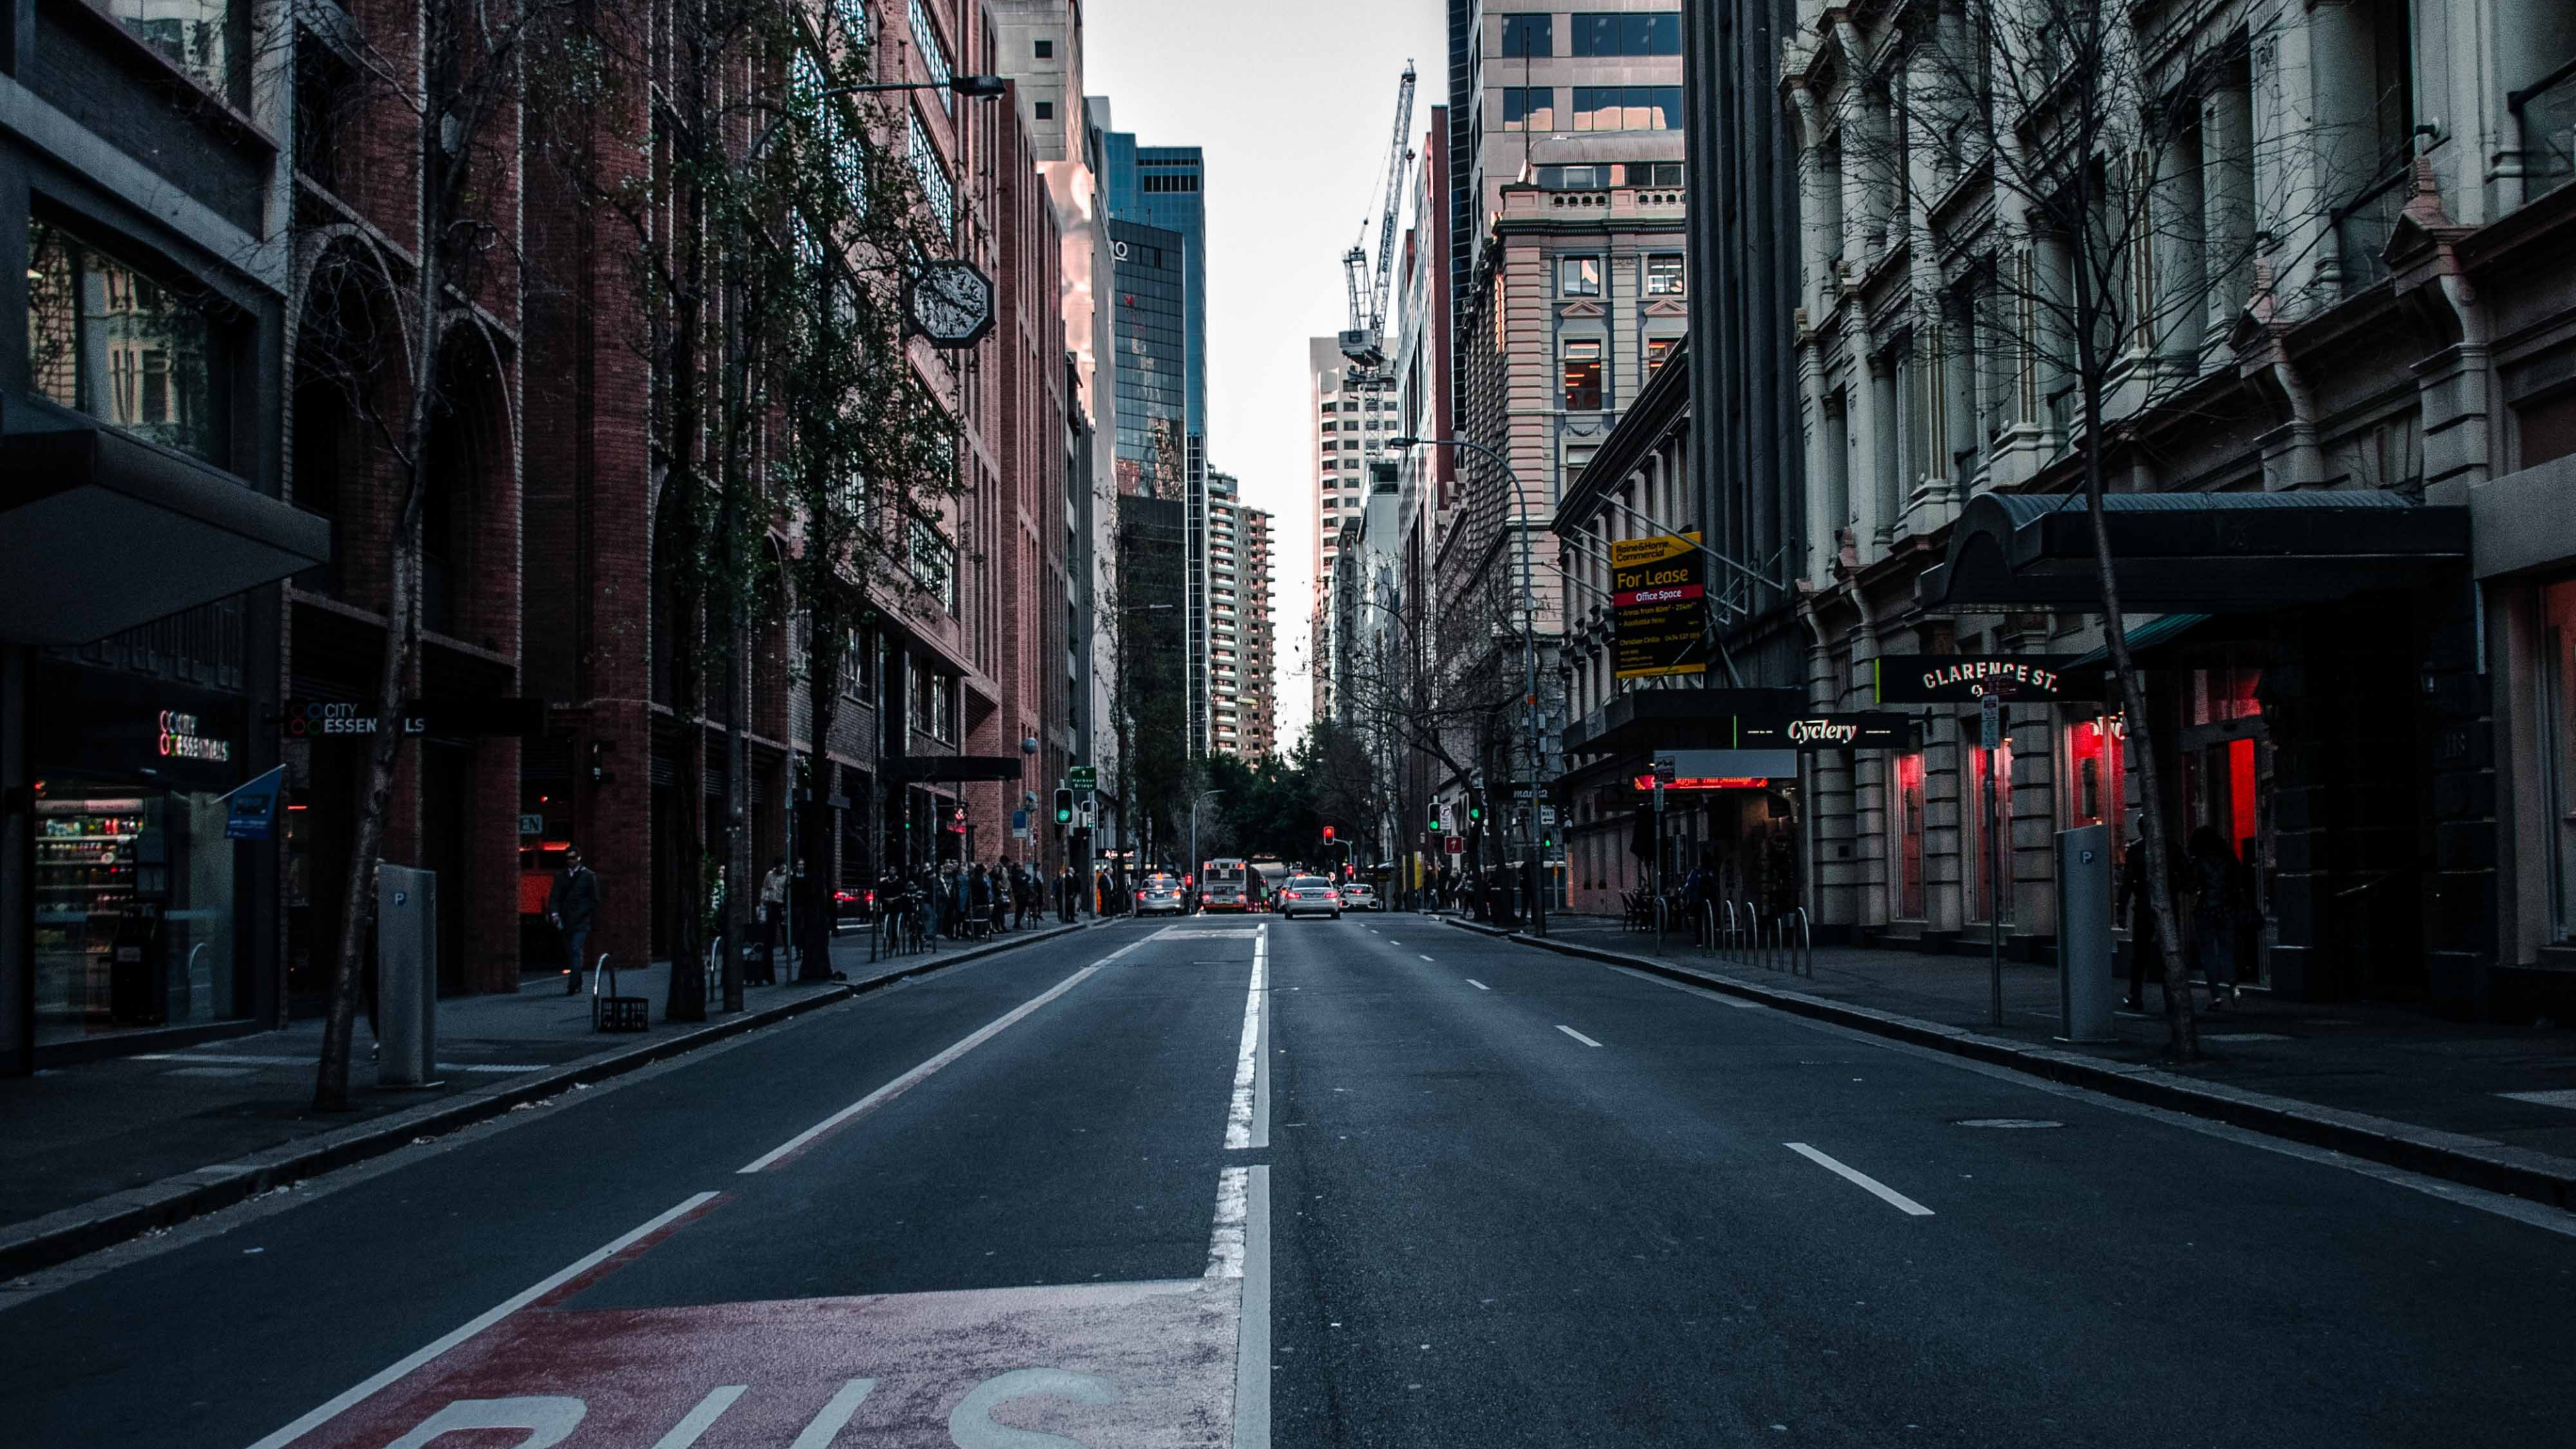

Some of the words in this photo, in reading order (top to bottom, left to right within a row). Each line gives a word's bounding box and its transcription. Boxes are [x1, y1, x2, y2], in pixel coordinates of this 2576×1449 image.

[1616, 549, 1664, 562] Commercial
[1617, 573, 1642, 589] For
[1646, 568, 1689, 586] Lease
[1635, 591, 1658, 602] Office
[1659, 590, 1682, 601] Space
[1923, 661, 2029, 690] CLARENCE
[2032, 668, 2058, 692] ST.
[325, 703, 358, 718] CITY
[325, 718, 425, 733] ESSENLS
[1787, 718, 1858, 745] Cyclery
[2083, 851, 2092, 863] P
[394, 893, 405, 905] P
